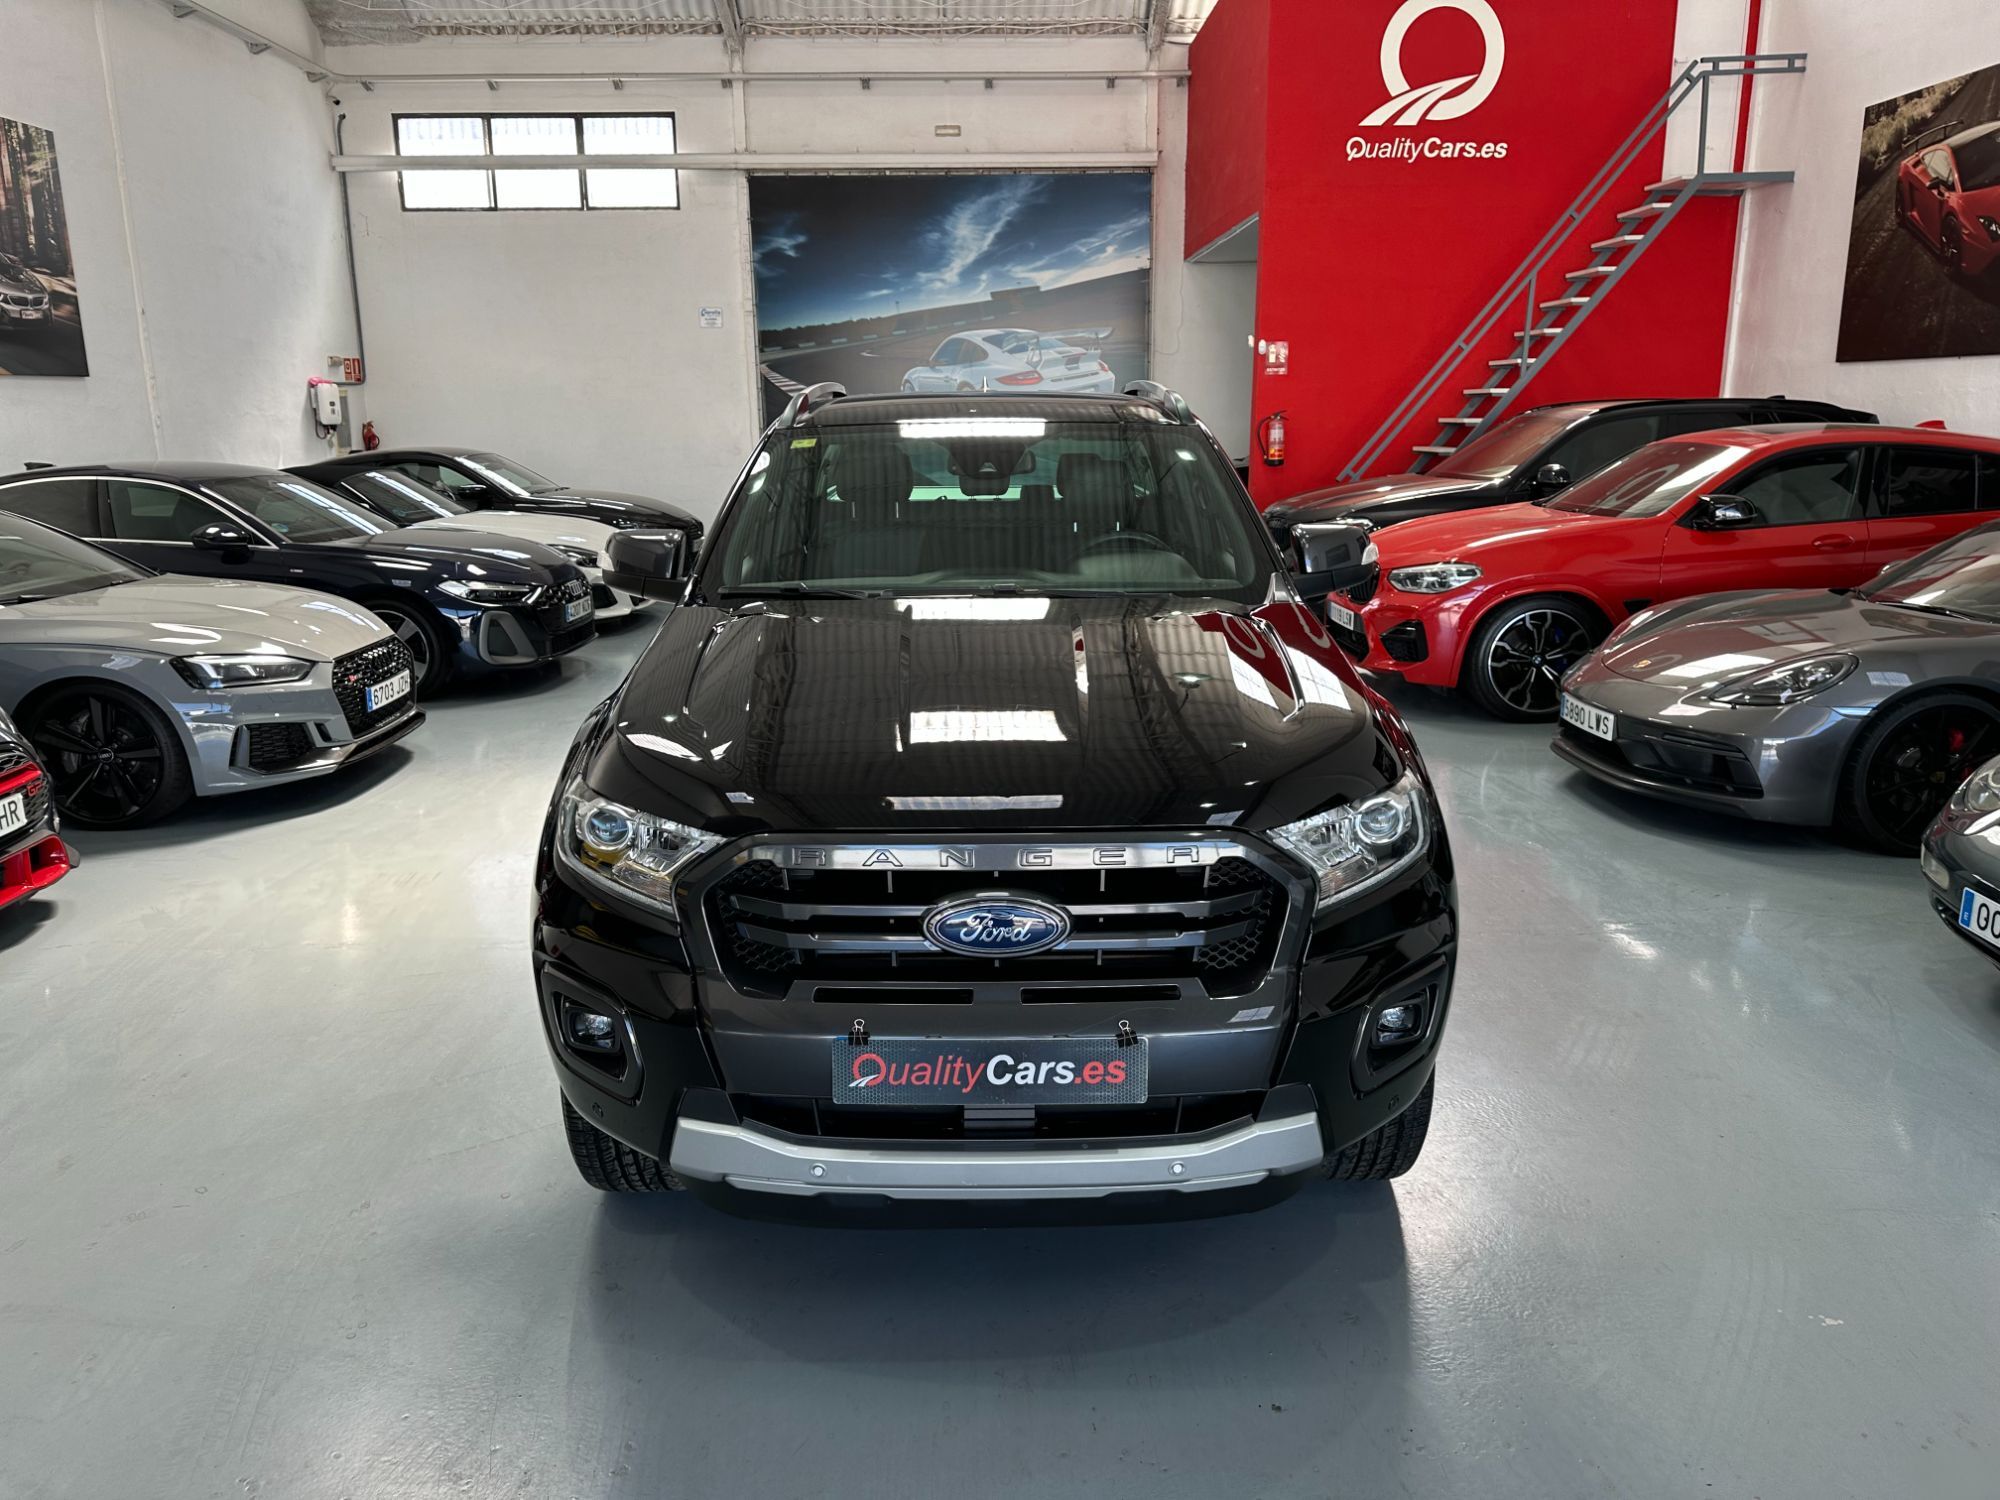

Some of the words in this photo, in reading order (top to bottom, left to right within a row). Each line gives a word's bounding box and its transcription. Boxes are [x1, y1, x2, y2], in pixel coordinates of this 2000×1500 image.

[1346, 136, 1508, 163] QualityCars.es
[373, 682, 395, 705] 6703
[1565, 699, 1586, 725] 5890
[1588, 710, 1609, 735] LWS
[793, 845, 1199, 868] RANGER
[958, 912, 1032, 943] Ford
[849, 1053, 1127, 1092] QualityCars.es
